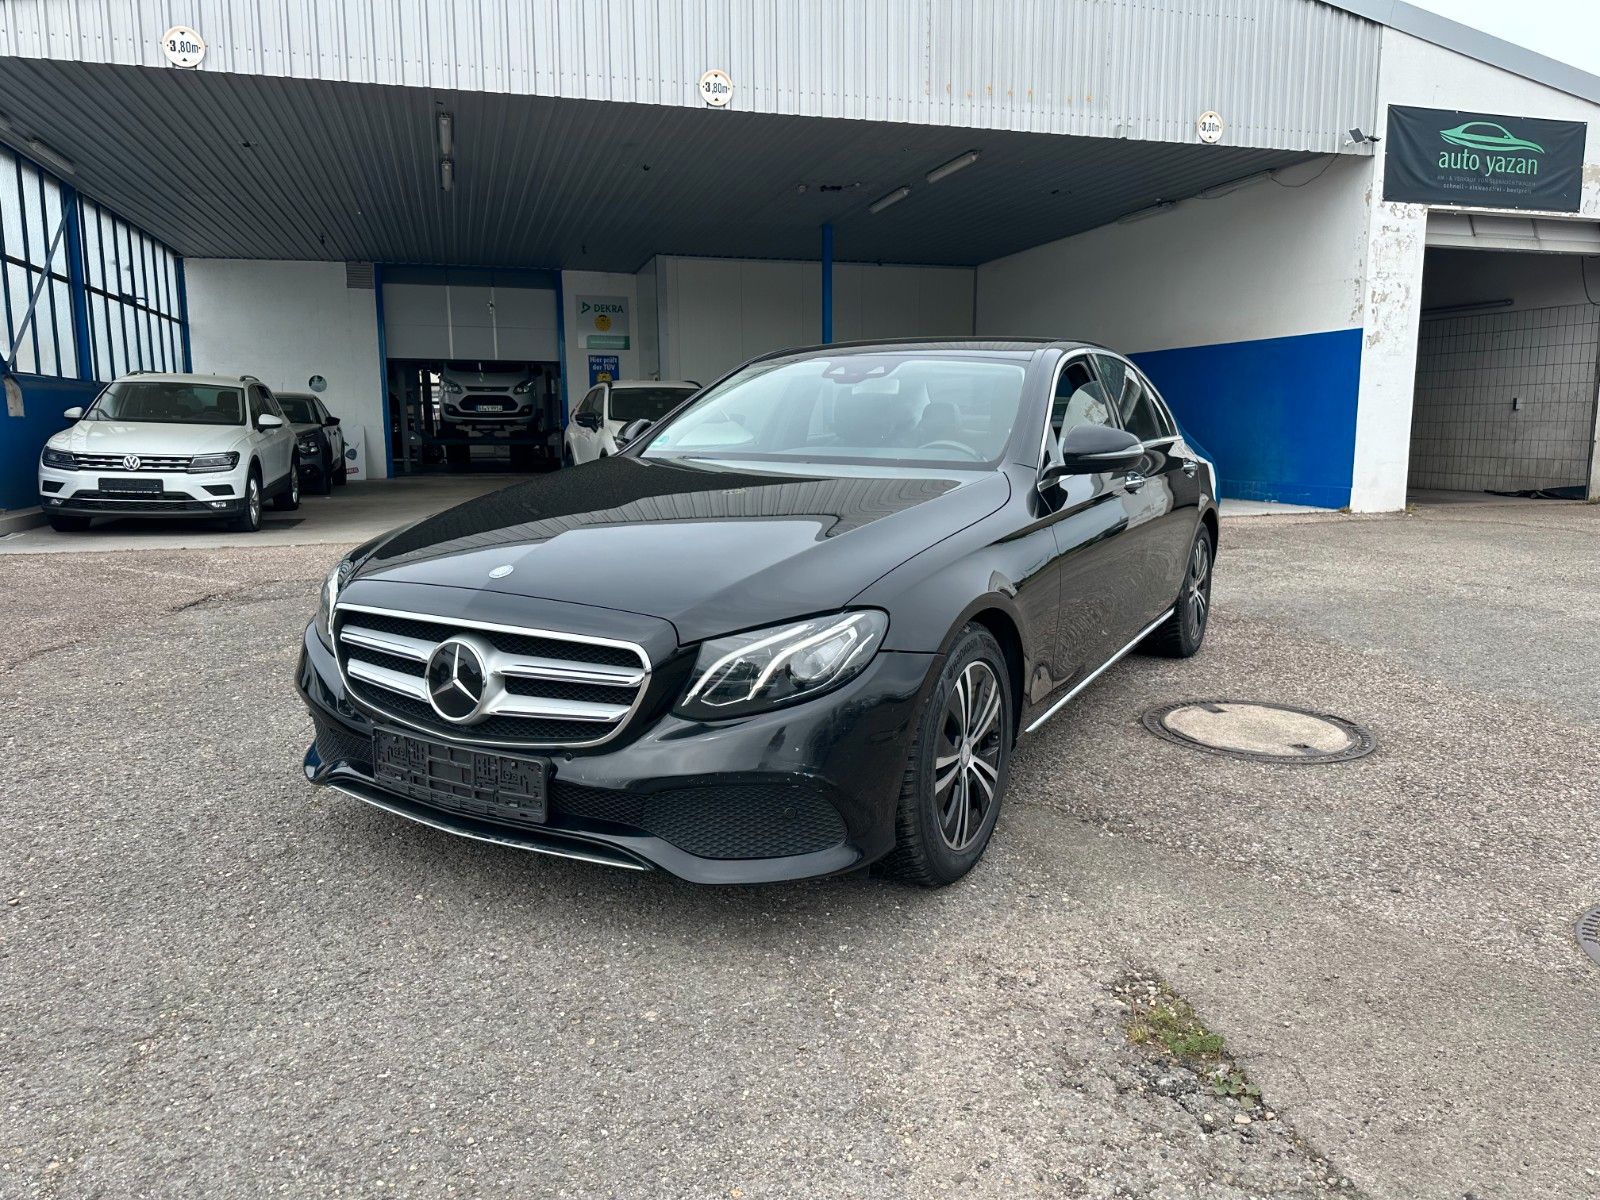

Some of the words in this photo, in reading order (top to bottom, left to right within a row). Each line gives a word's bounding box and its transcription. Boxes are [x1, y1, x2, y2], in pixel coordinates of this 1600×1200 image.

[170, 40, 199, 53] 3,80m
[705, 82, 728, 94] 3,80m
[1438, 149, 1480, 171] auto
[1485, 155, 1538, 177] yazan
[593, 303, 624, 313] DEKRA
